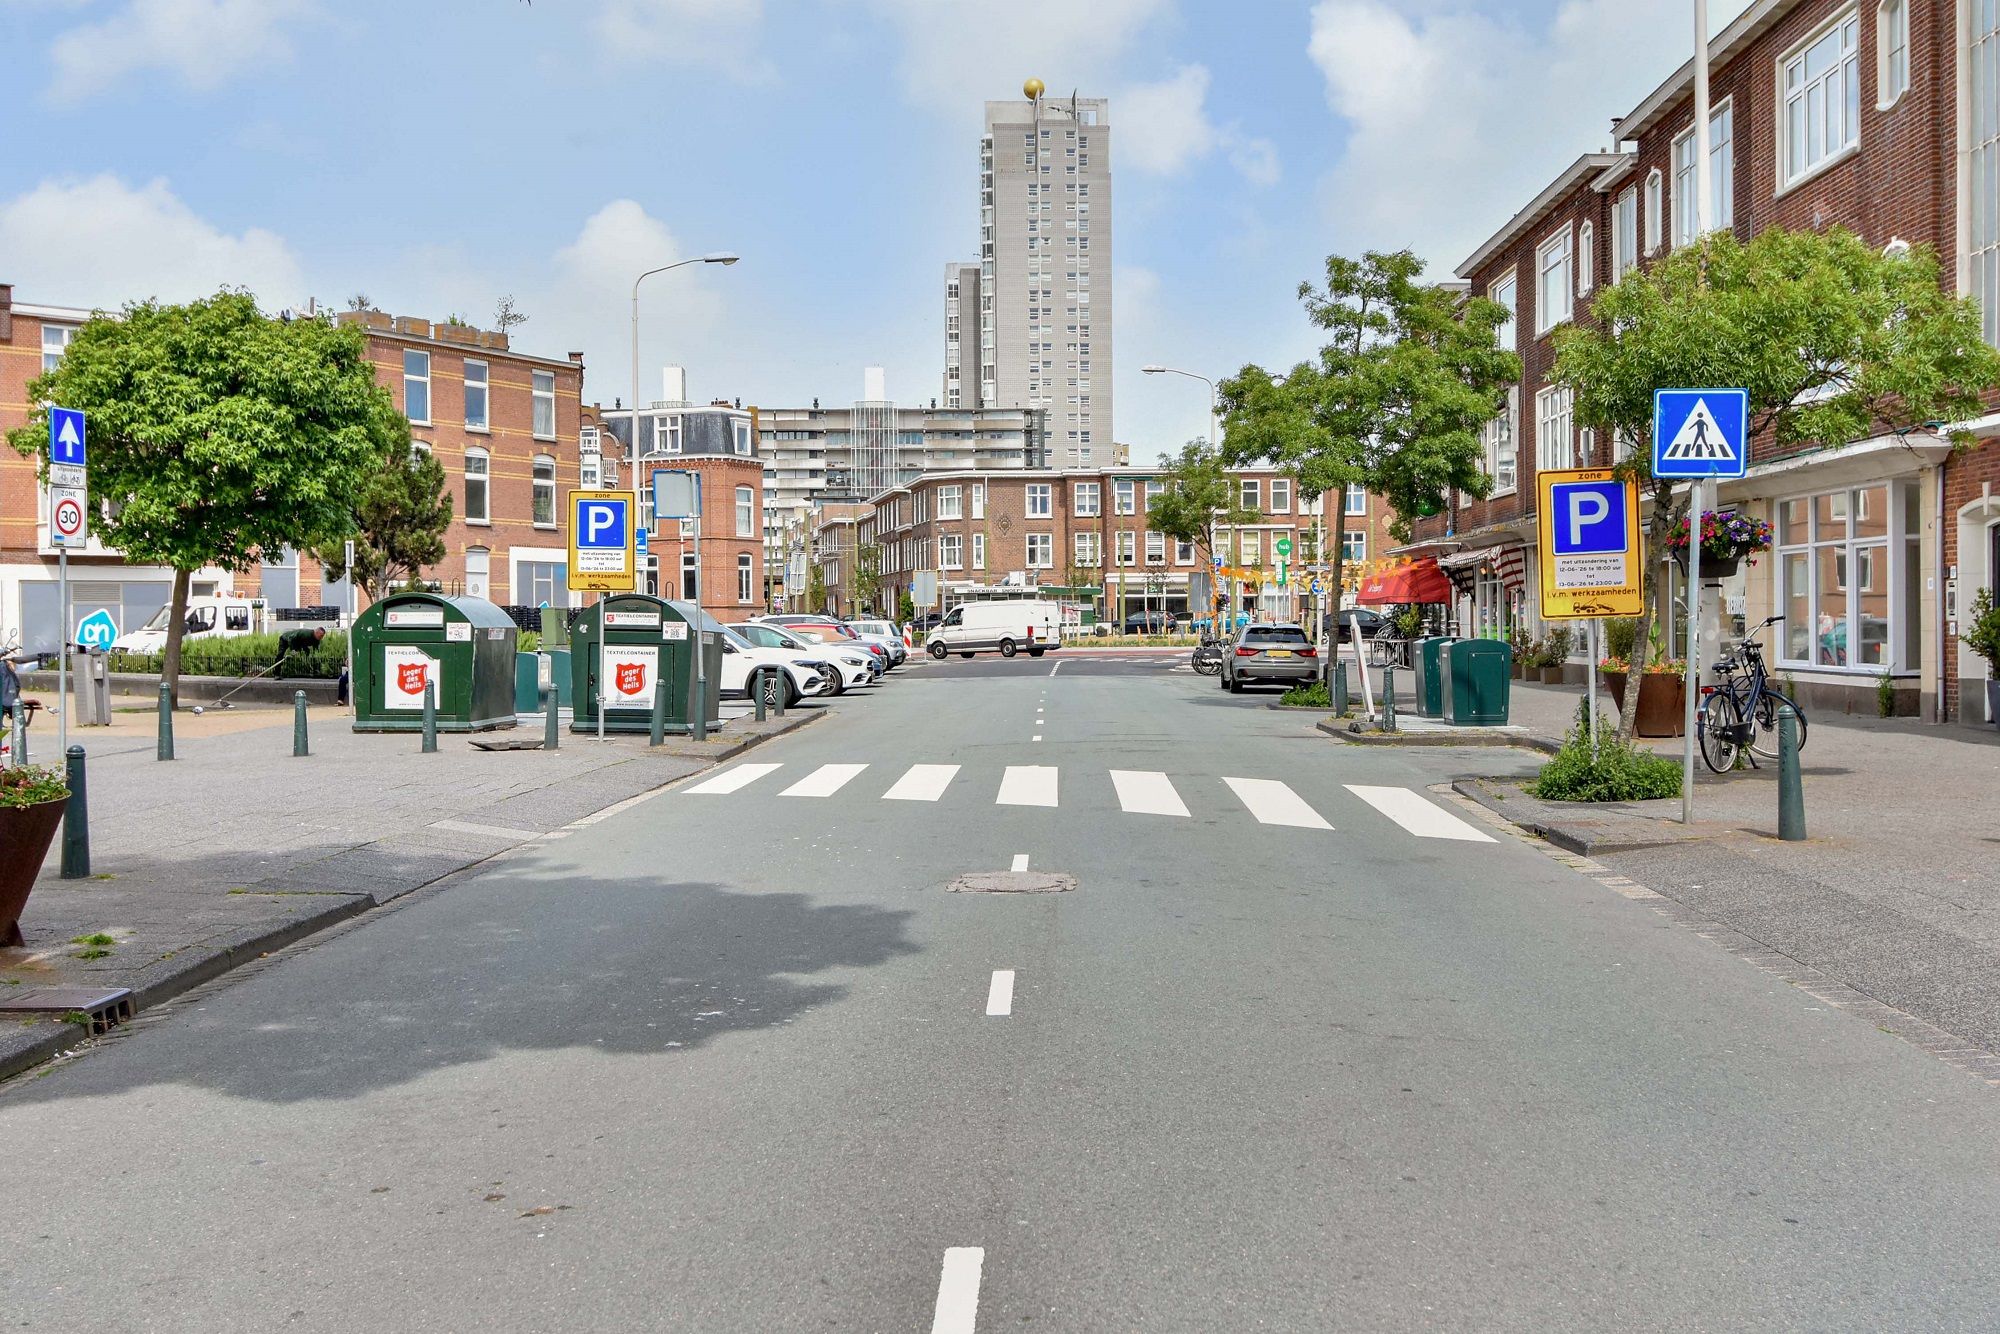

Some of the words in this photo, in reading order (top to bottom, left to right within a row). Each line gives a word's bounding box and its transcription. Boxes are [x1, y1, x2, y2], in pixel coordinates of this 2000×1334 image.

[60, 510, 77, 524] 30
[1569, 491, 1610, 545] P
[588, 506, 614, 542] P
[1572, 588, 1637, 597] werkzaamheden
[403, 668, 422, 677] Leger
[622, 668, 640, 677] Leger
[405, 682, 421, 690] Heils
[623, 682, 640, 690] Heils
